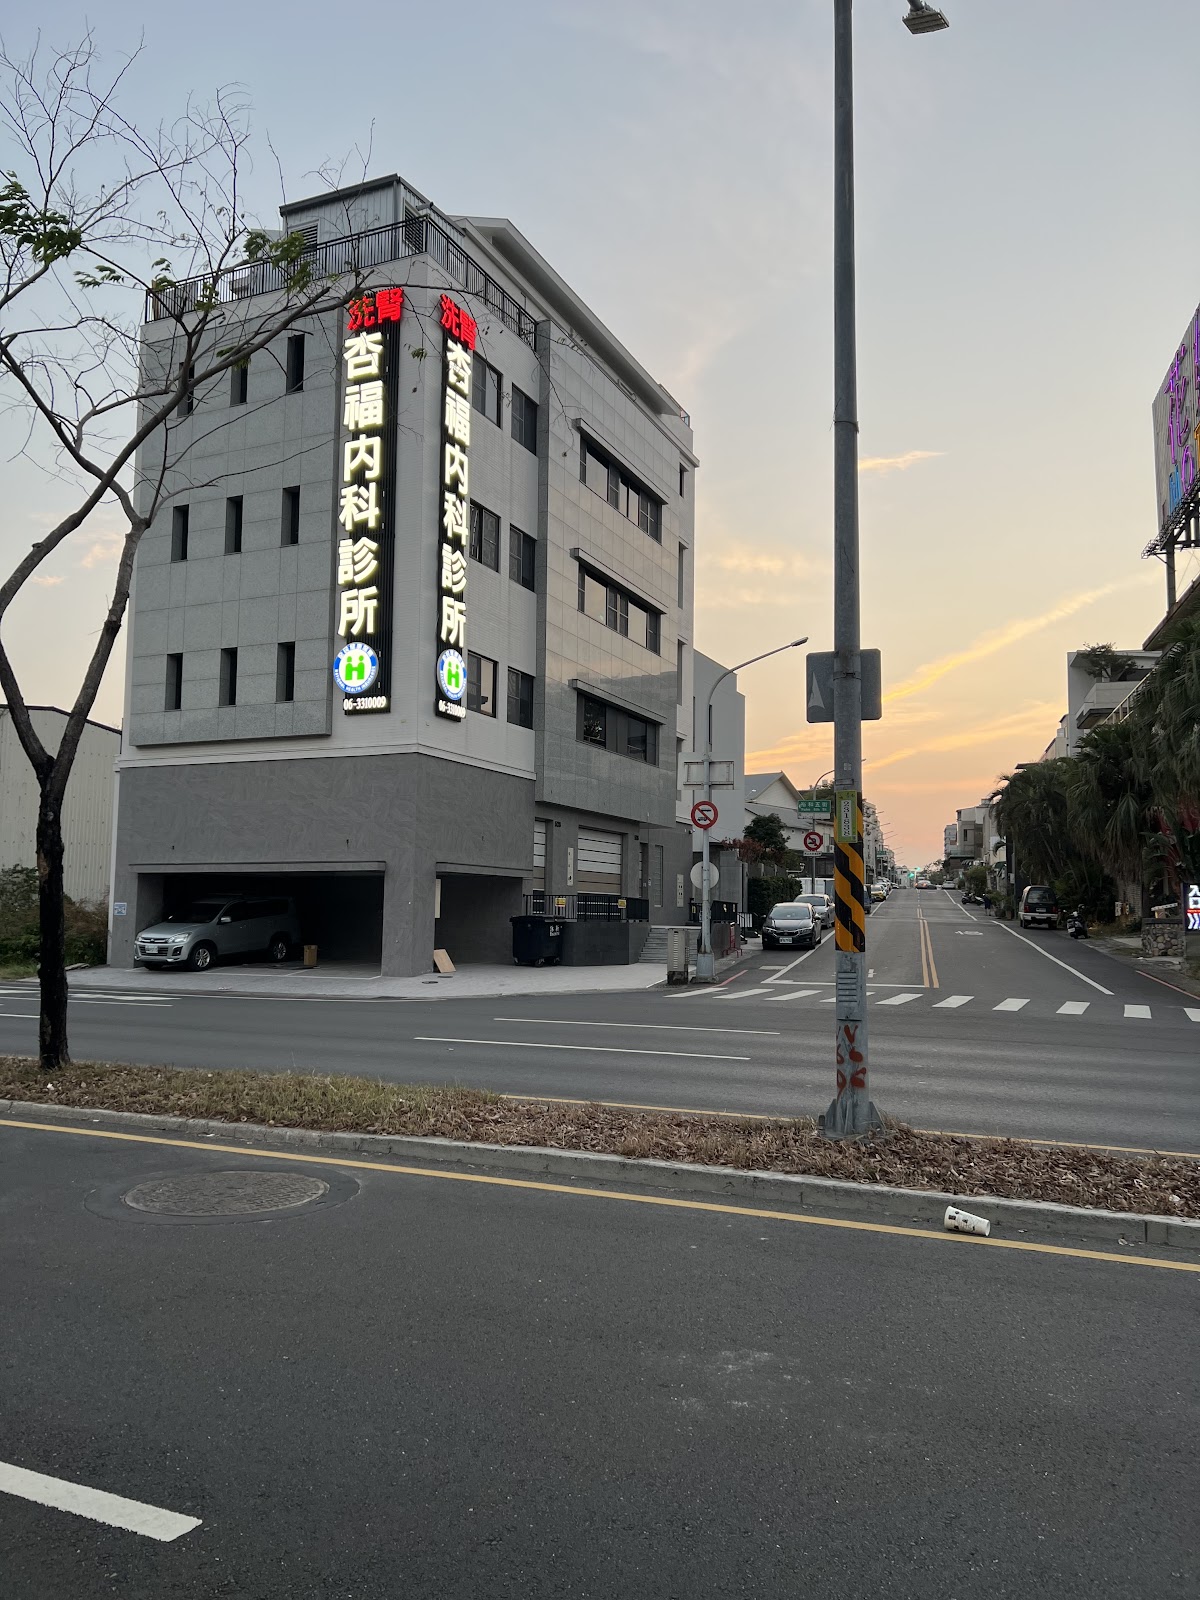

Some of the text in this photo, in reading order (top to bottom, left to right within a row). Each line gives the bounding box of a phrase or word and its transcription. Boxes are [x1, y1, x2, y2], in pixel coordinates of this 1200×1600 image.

[347, 287, 404, 331] 洗腎
[439, 293, 477, 350] 洗腎
[343, 696, 387, 710] 06-3310009
